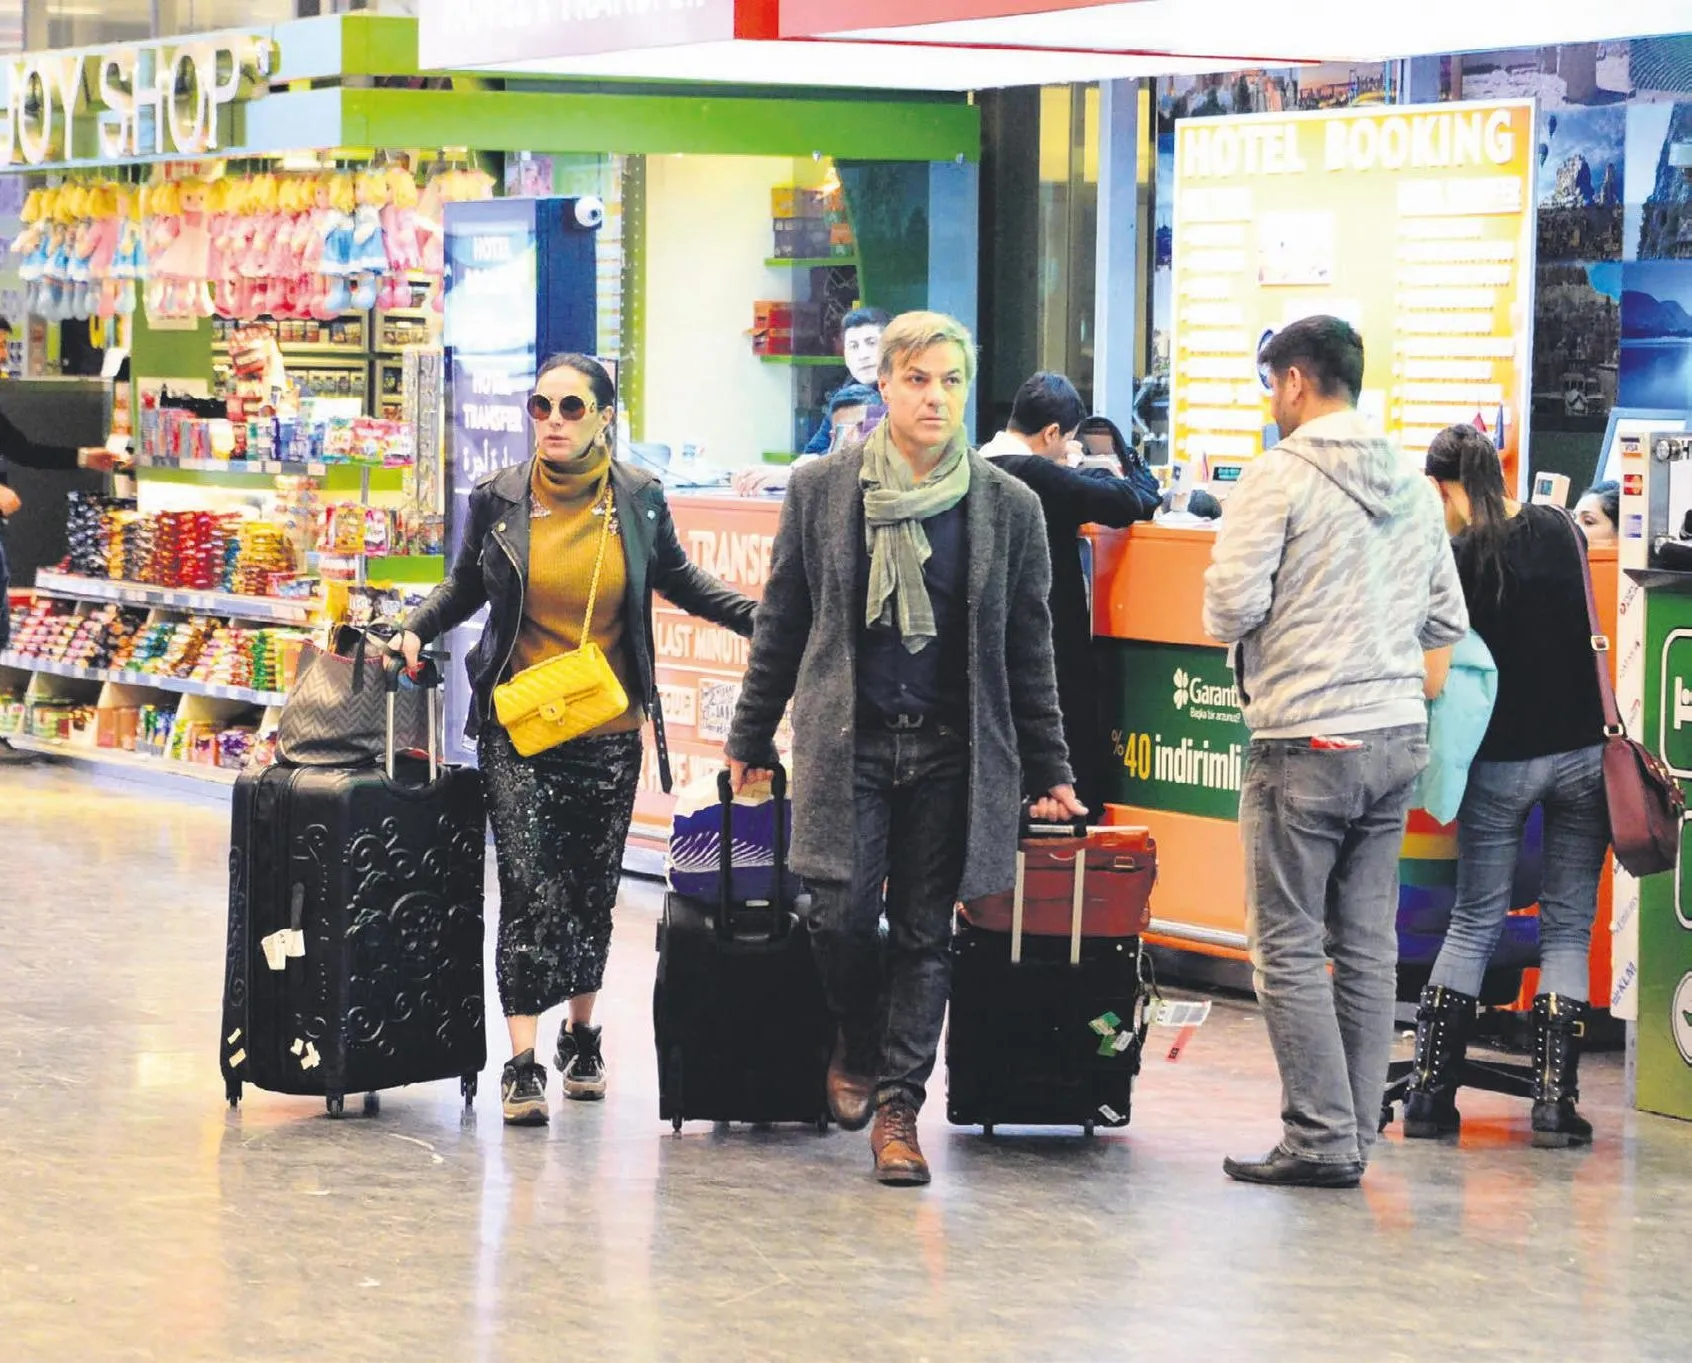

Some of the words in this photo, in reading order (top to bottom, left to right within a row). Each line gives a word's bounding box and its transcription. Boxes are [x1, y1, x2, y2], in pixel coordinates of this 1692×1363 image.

[100, 40, 240, 158] SHOP
[1184, 124, 1305, 176] HOTEL
[1325, 108, 1515, 172] BOOKING
[689, 530, 774, 585] TRANSF
[657, 621, 692, 658] LAST
[1190, 677, 1241, 708] Garant
[1155, 734, 1241, 791] indirimli
